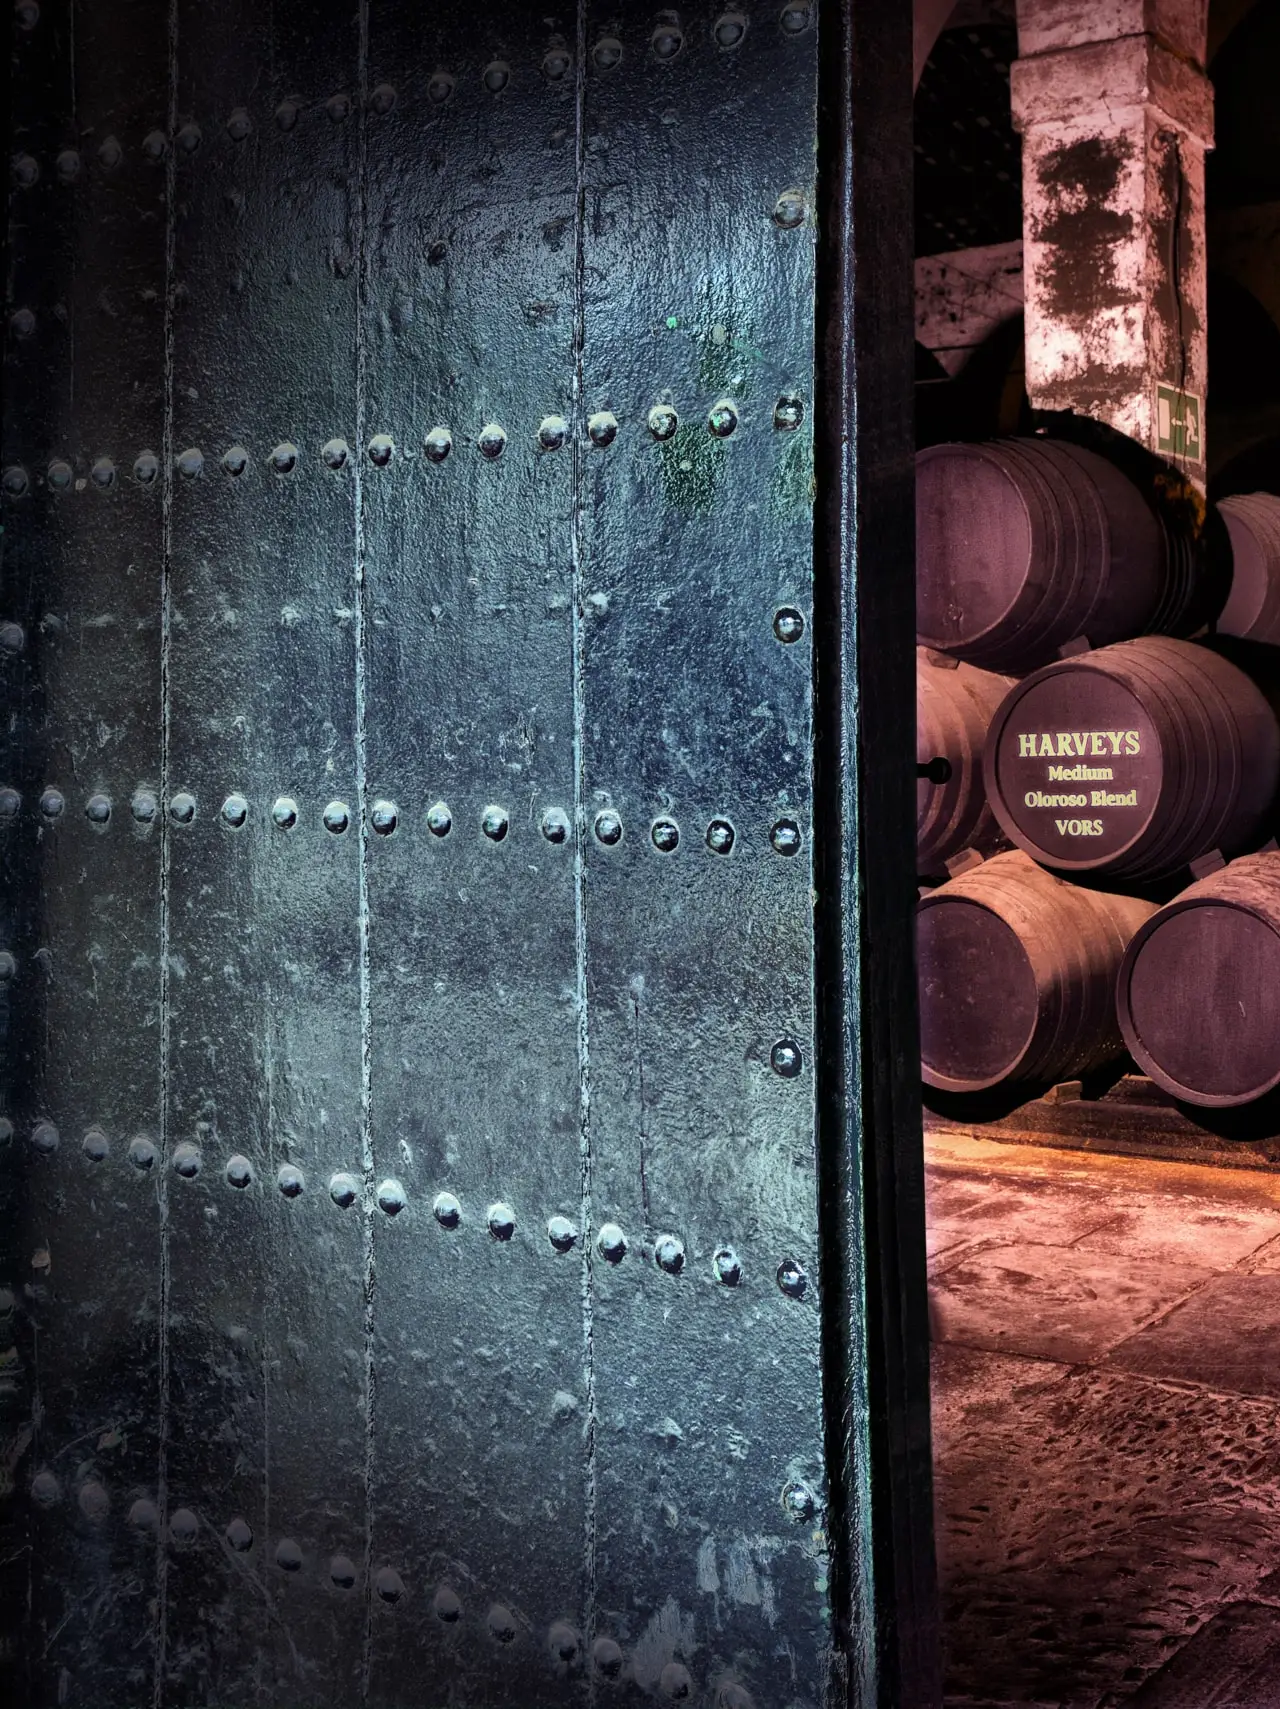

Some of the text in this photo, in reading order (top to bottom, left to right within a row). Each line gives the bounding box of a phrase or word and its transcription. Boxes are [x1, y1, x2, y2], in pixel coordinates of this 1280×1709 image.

[1018, 731, 1141, 757] HARVEYS
[1048, 764, 1114, 781] Medium
[1024, 789, 1138, 808] Oloroso Blend
[1055, 819, 1104, 836] VORS
